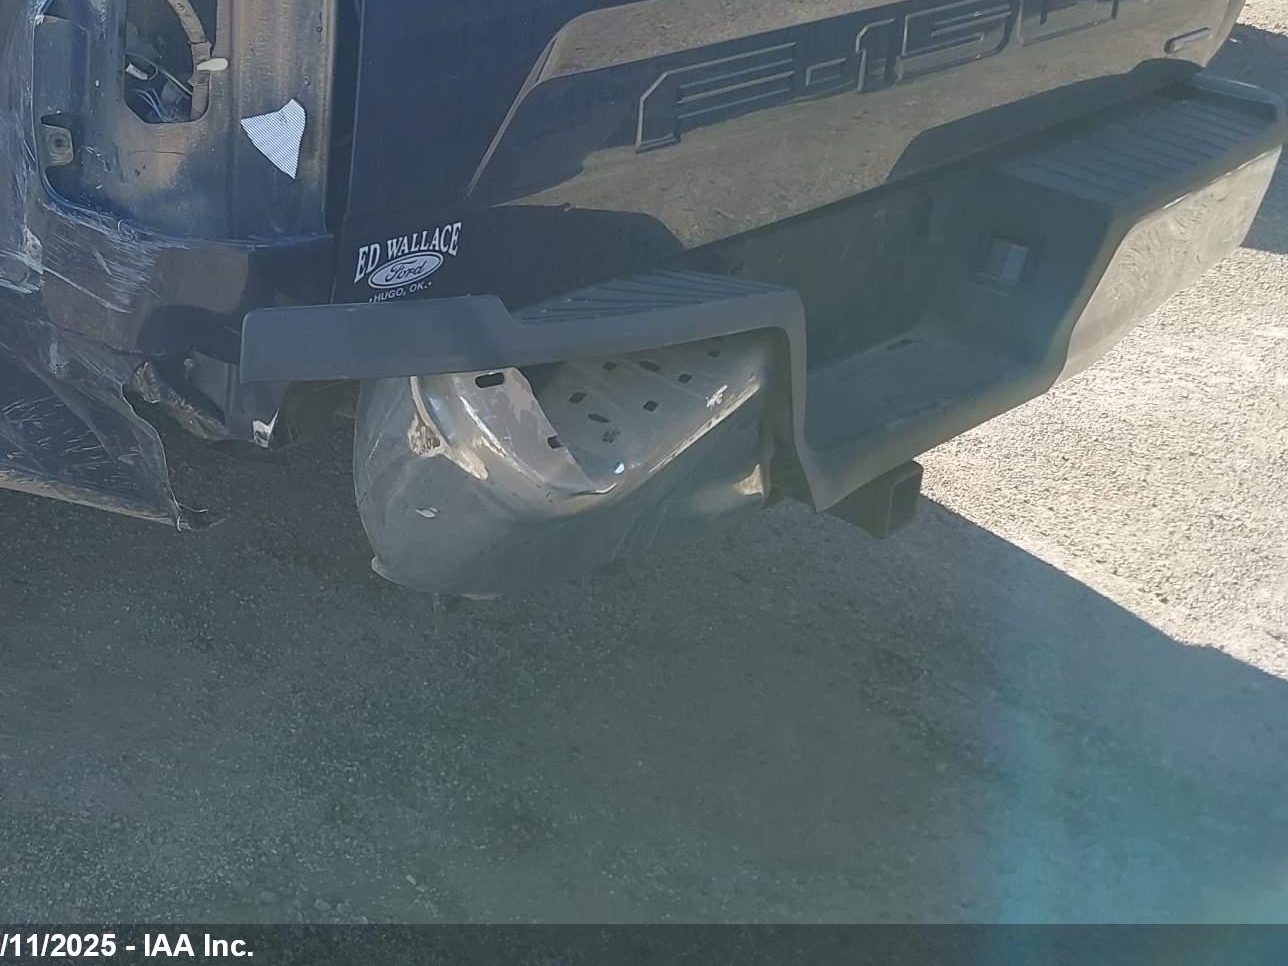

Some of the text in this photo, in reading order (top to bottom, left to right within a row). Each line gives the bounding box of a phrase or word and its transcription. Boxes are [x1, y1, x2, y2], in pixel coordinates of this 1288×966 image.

[353, 221, 463, 283] ED WALLACE
[386, 260, 428, 281] Ford
